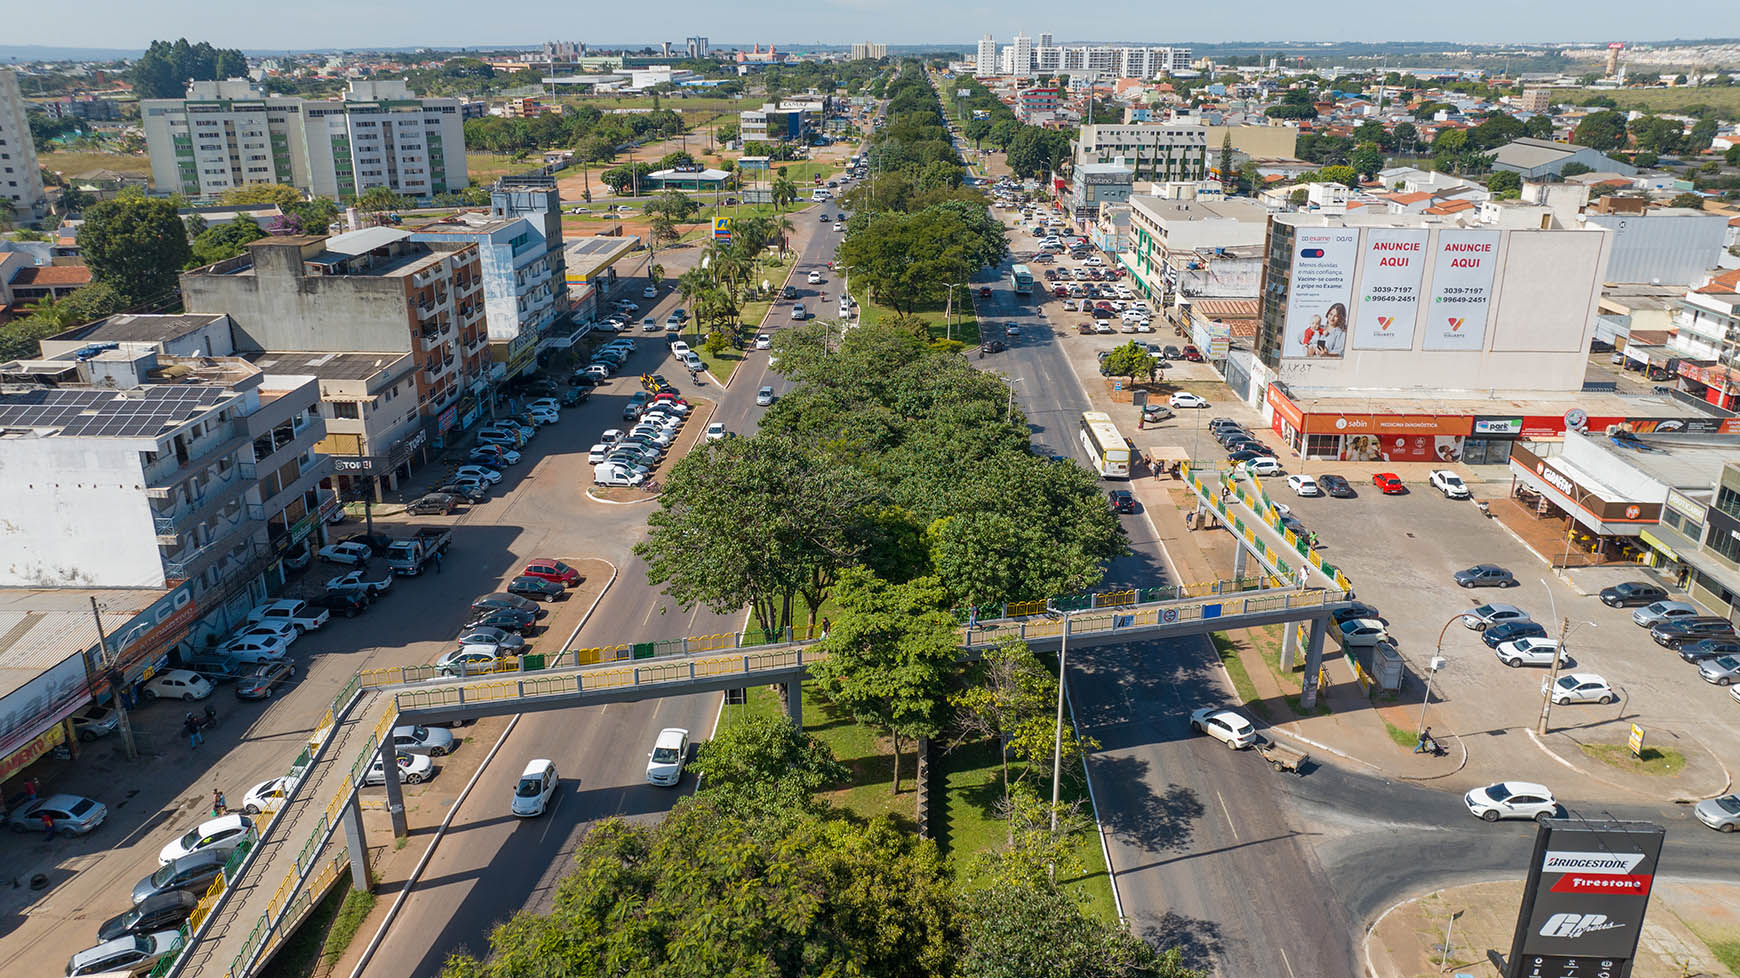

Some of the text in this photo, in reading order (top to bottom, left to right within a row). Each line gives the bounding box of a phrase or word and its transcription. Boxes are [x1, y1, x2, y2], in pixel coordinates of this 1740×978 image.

[1373, 242, 1421, 251] ANUNCIE
[1444, 243, 1491, 252] ANUNCIE
[1379, 257, 1409, 267] AQUI
[1451, 258, 1480, 268] AQUI
[1371, 295, 1416, 303] 99649-2451
[1442, 296, 1487, 304] 99649-2451
[1348, 420, 1368, 428] sabin
[1547, 857, 1629, 869] BRIDGESTONE
[1572, 877, 1641, 888] Firestone
